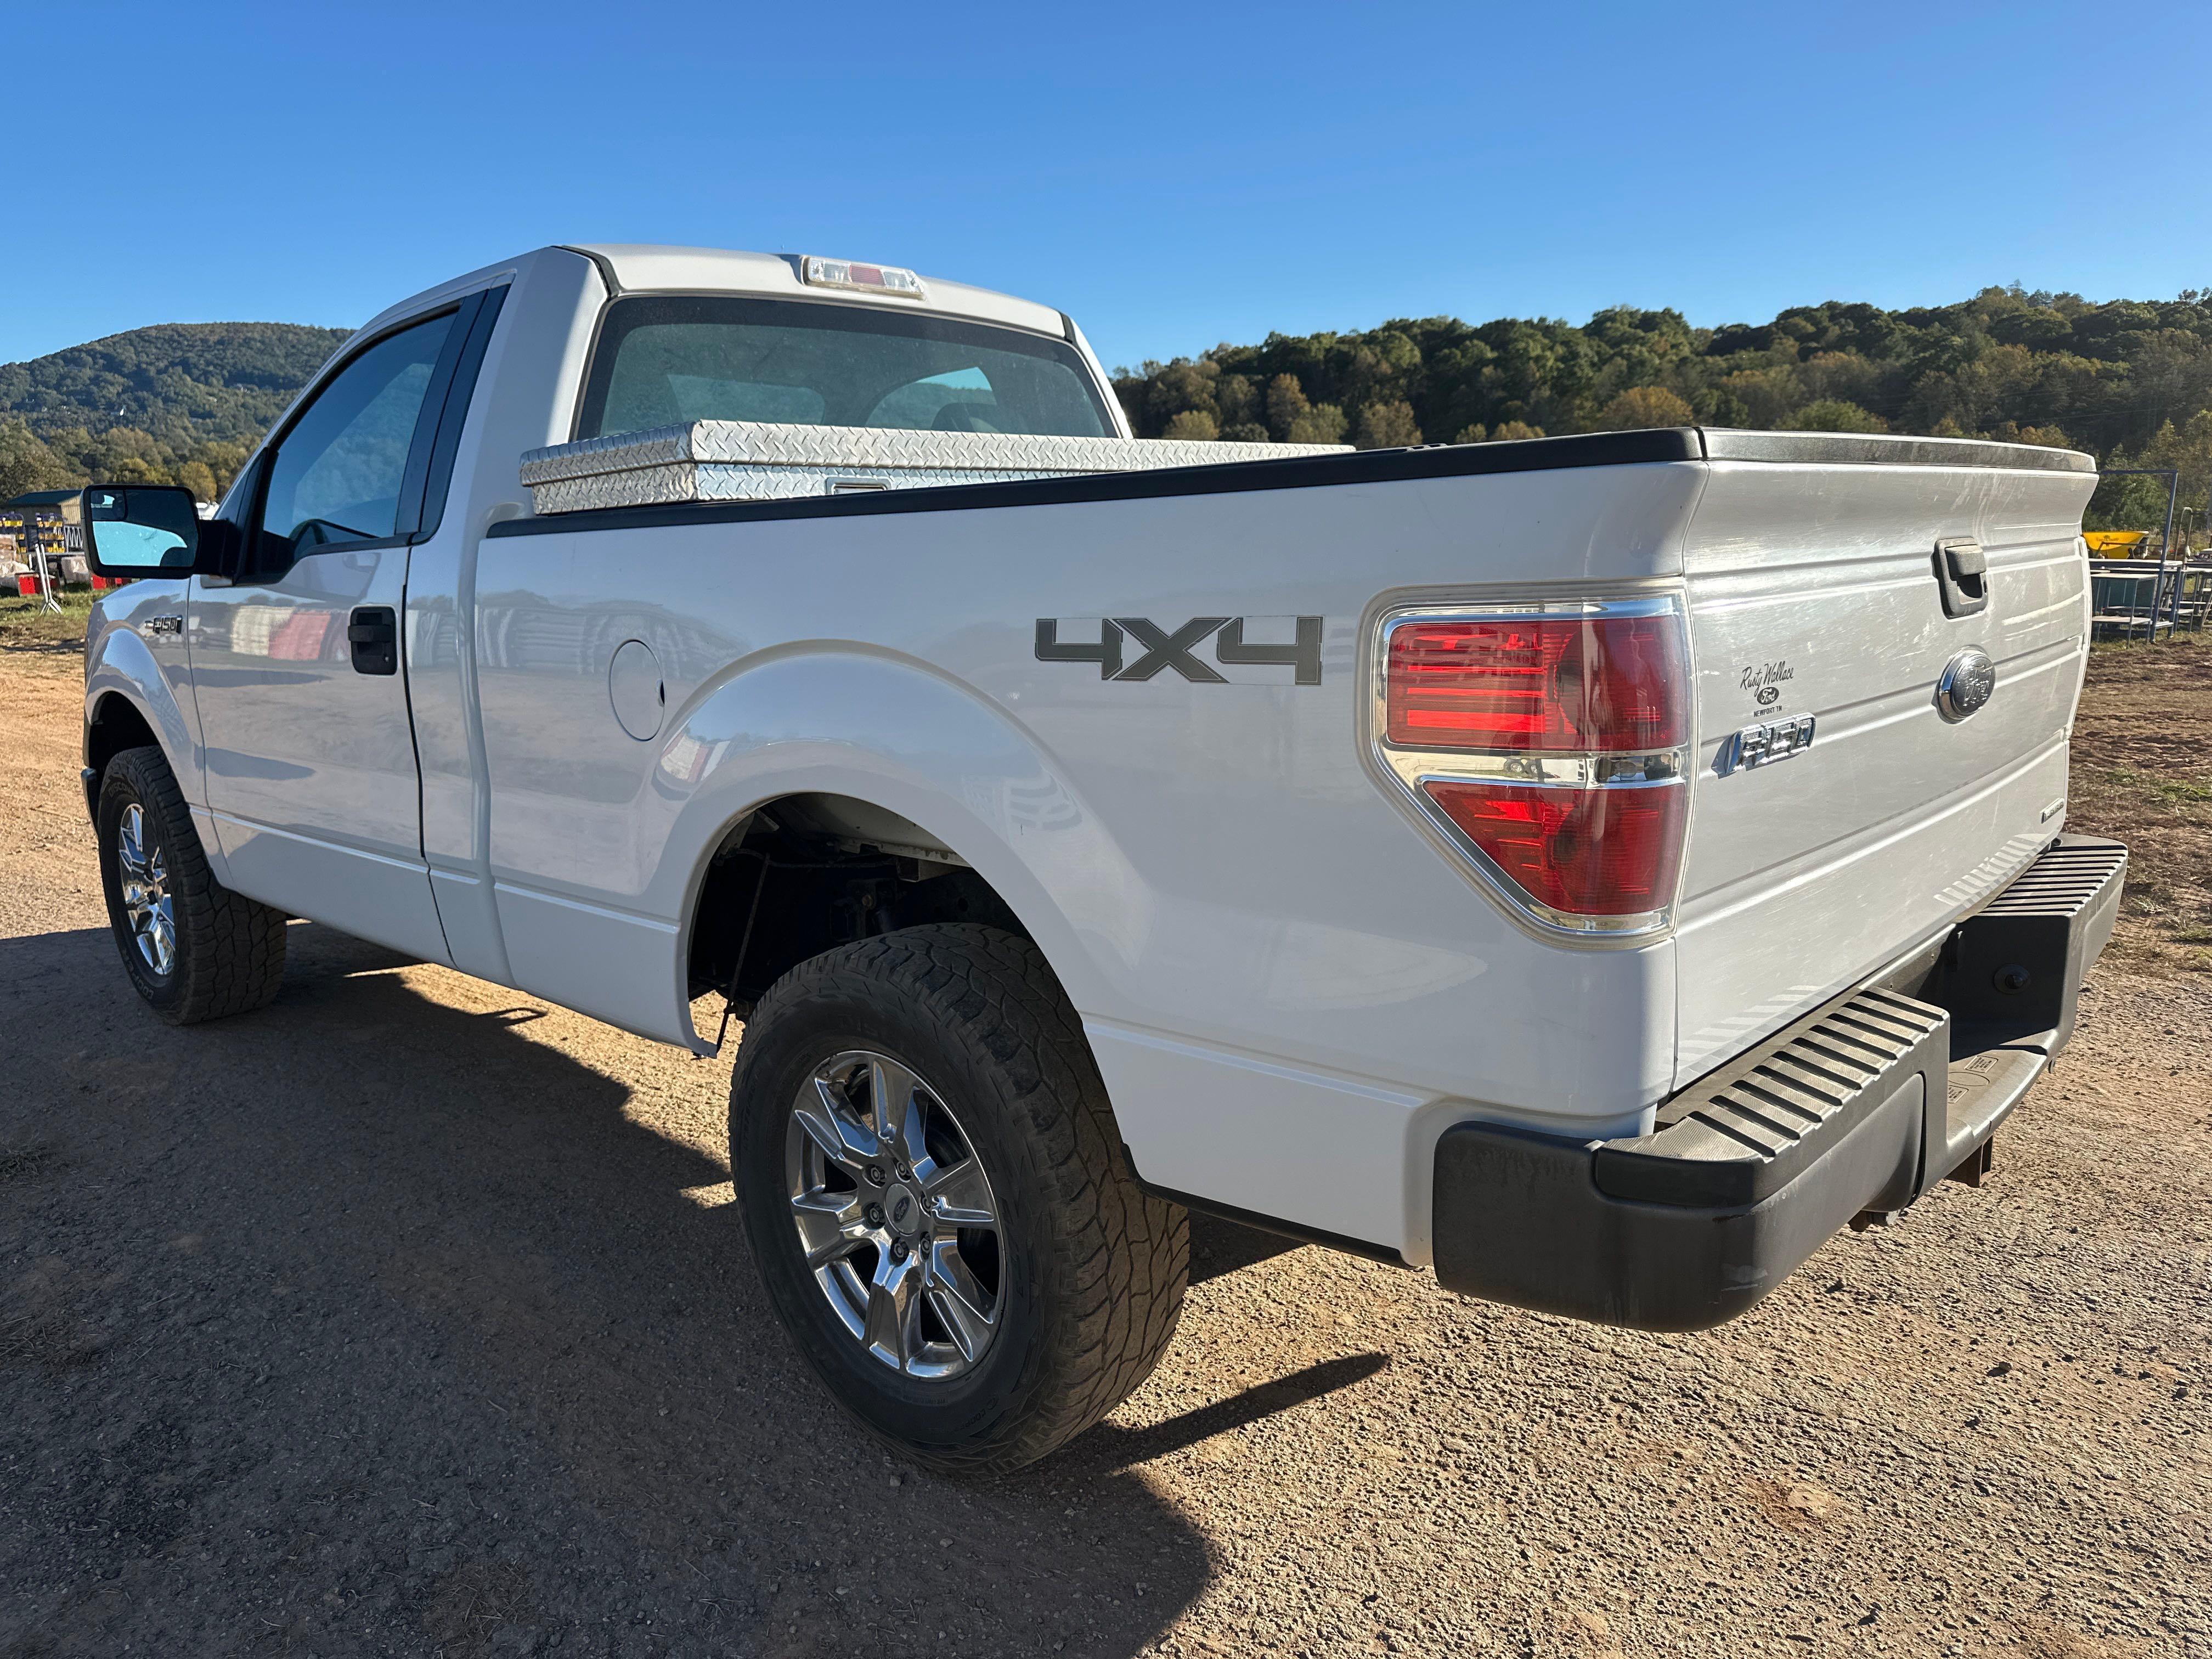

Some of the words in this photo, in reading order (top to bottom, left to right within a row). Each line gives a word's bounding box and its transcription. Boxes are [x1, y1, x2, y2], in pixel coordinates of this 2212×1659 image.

[1740, 666, 1763, 698] Rusty
[1763, 660, 1794, 685] Wallace
[1759, 687, 1777, 704] Ford
[1753, 706, 1775, 718] NEWPORT
[895, 1198, 909, 1220] Ford
